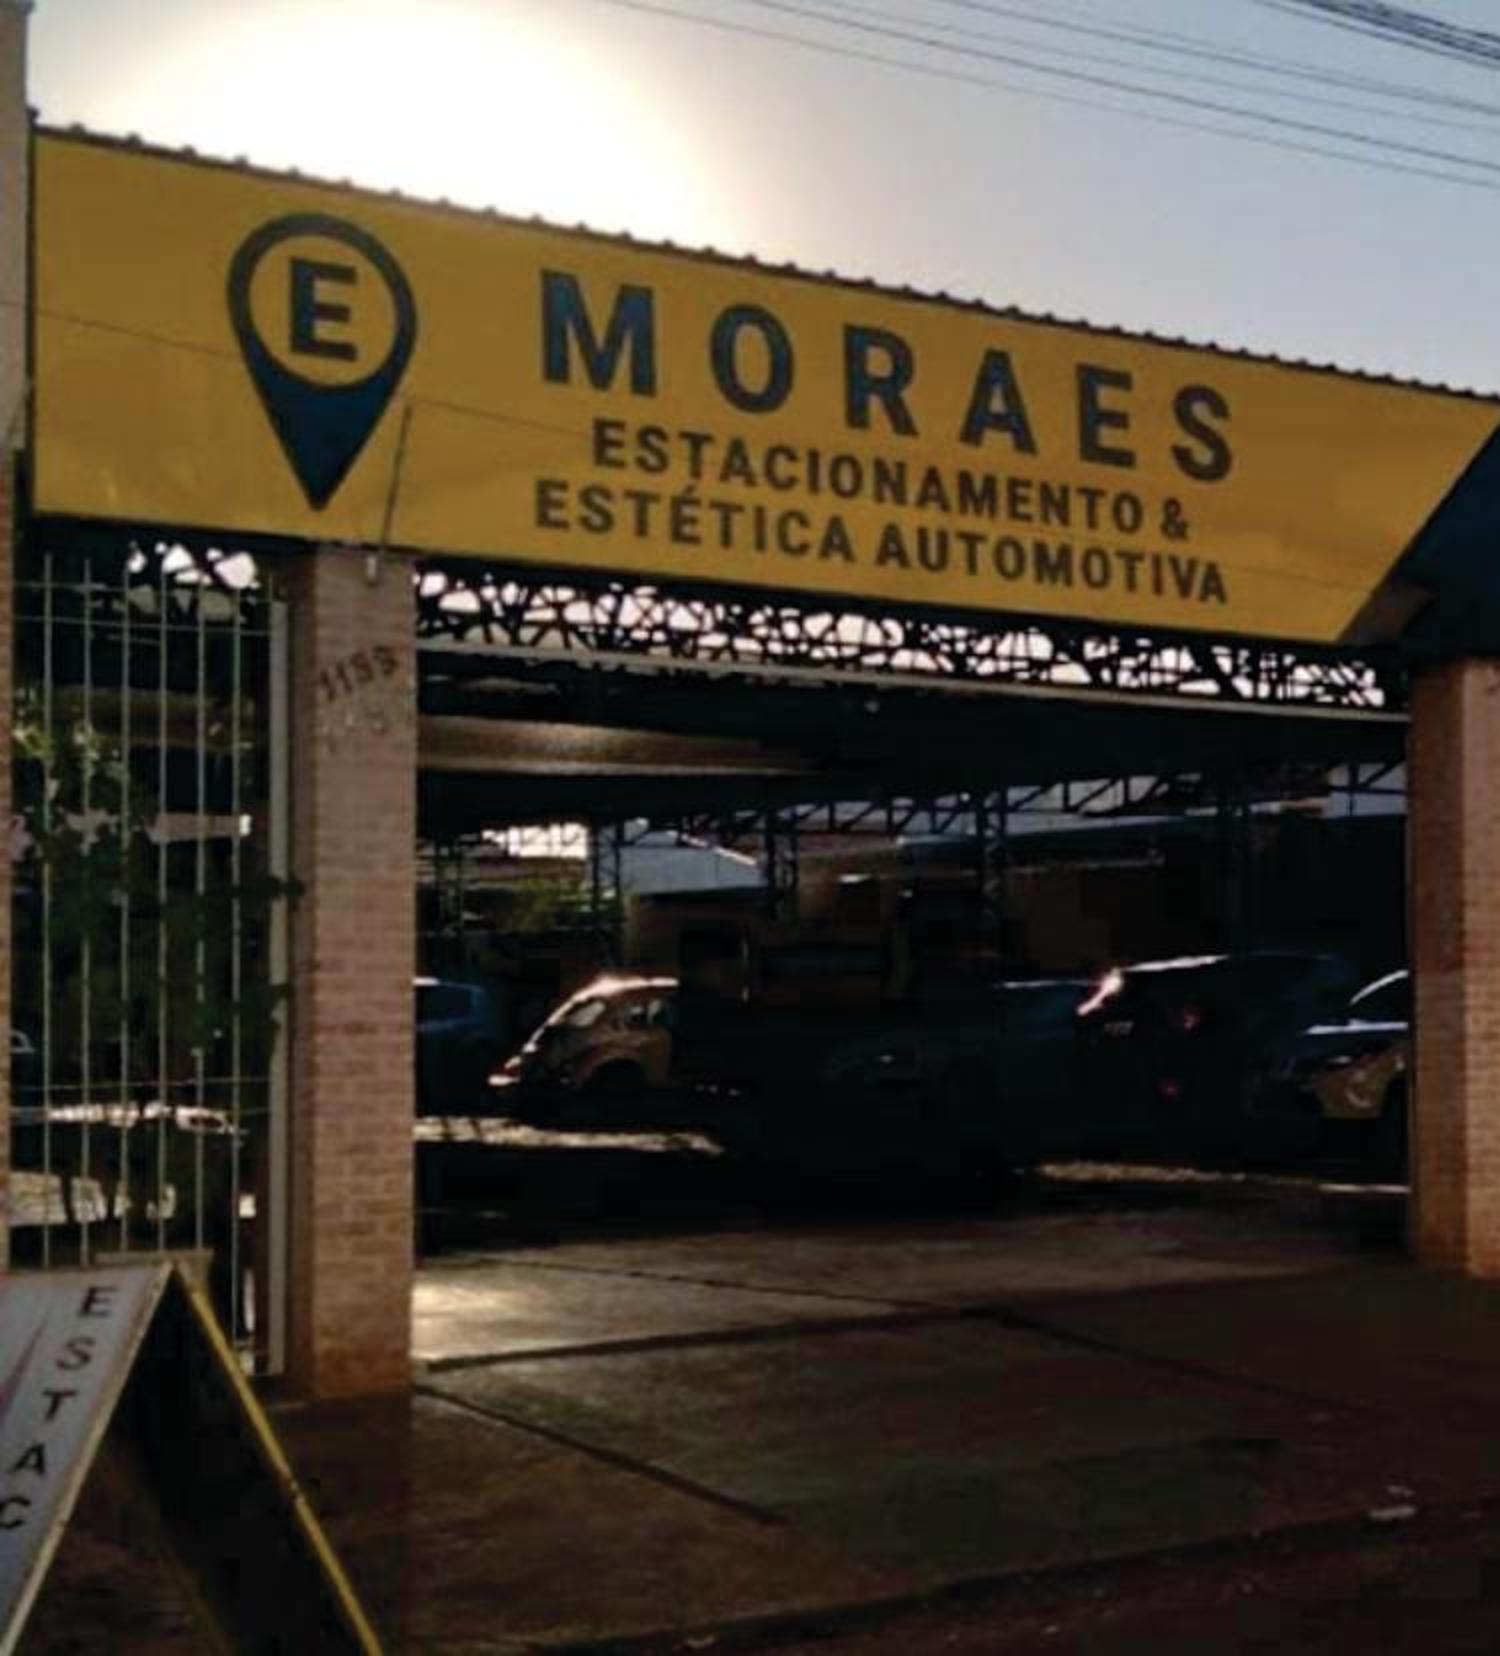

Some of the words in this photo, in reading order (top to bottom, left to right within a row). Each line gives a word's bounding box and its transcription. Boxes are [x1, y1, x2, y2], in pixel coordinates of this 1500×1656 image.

[289, 256, 359, 363] E
[540, 267, 1234, 482] MORAES
[535, 476, 857, 563] ESTÉTICA
[874, 522, 1229, 604] AUTOMOTIVA
[593, 416, 1144, 535] ESTACIONAMENTO
[1160, 496, 1189, 542] &
